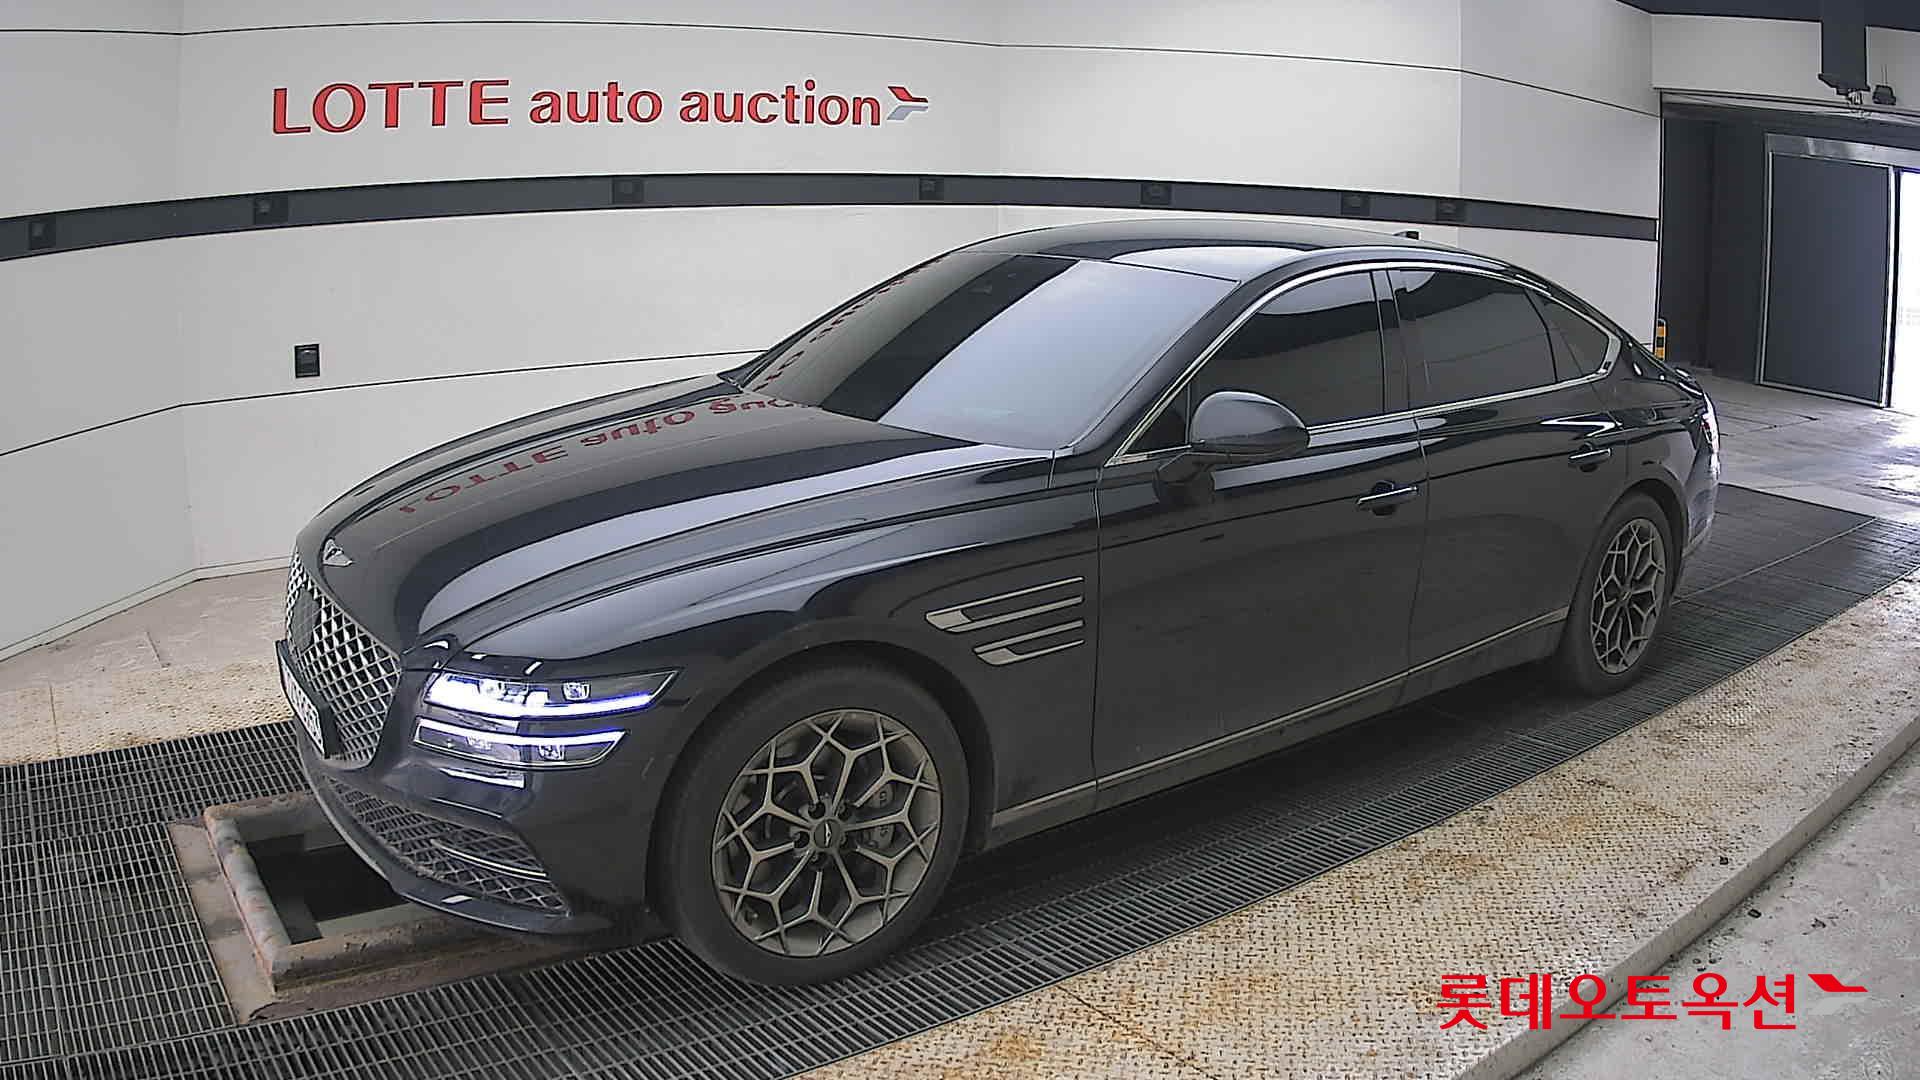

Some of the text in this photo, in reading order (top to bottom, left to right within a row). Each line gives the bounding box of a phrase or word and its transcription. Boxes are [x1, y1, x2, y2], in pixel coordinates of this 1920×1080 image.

[272, 79, 881, 136] LOTTE auto auction
